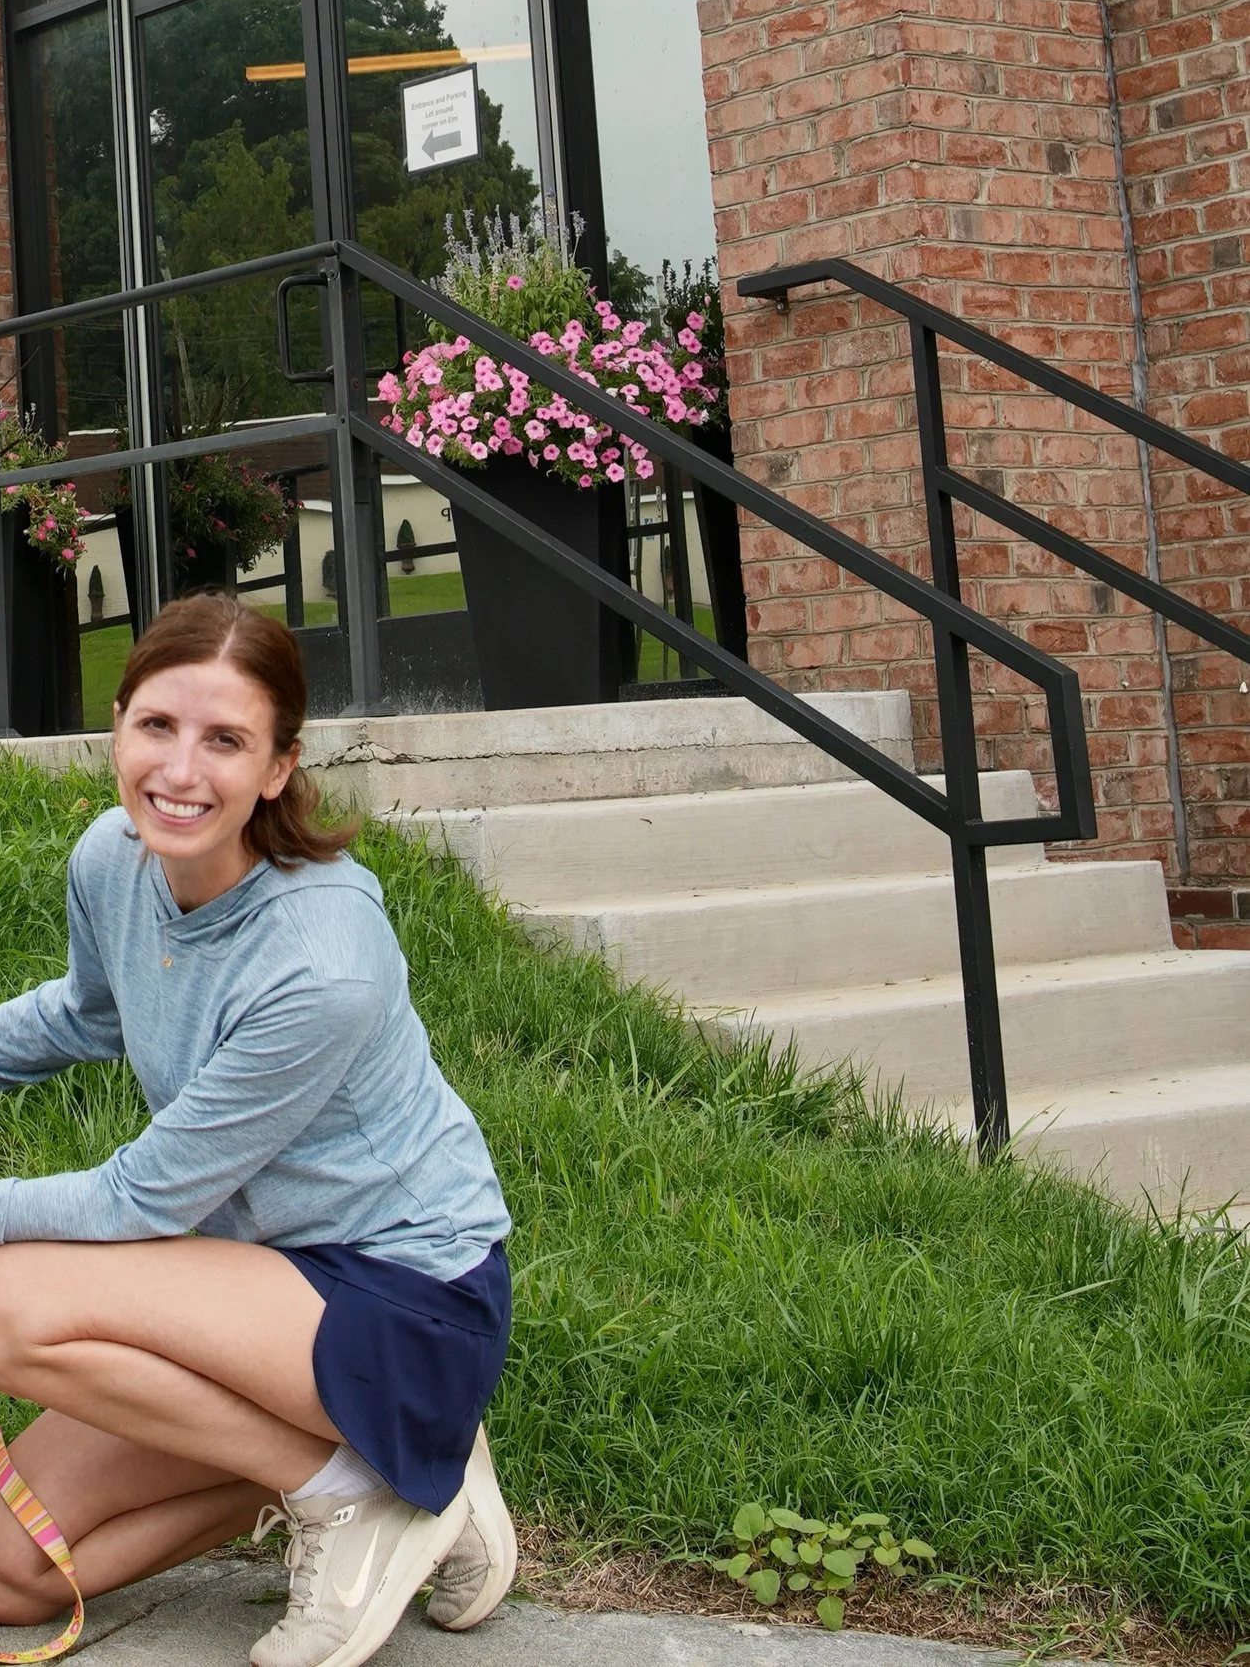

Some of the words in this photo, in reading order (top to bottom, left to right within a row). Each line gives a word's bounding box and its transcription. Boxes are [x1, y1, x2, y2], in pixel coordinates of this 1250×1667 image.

[411, 100, 435, 111] Entrance
[436, 95, 445, 105] and
[446, 90, 467, 102] Parking
[435, 105, 454, 116] around
